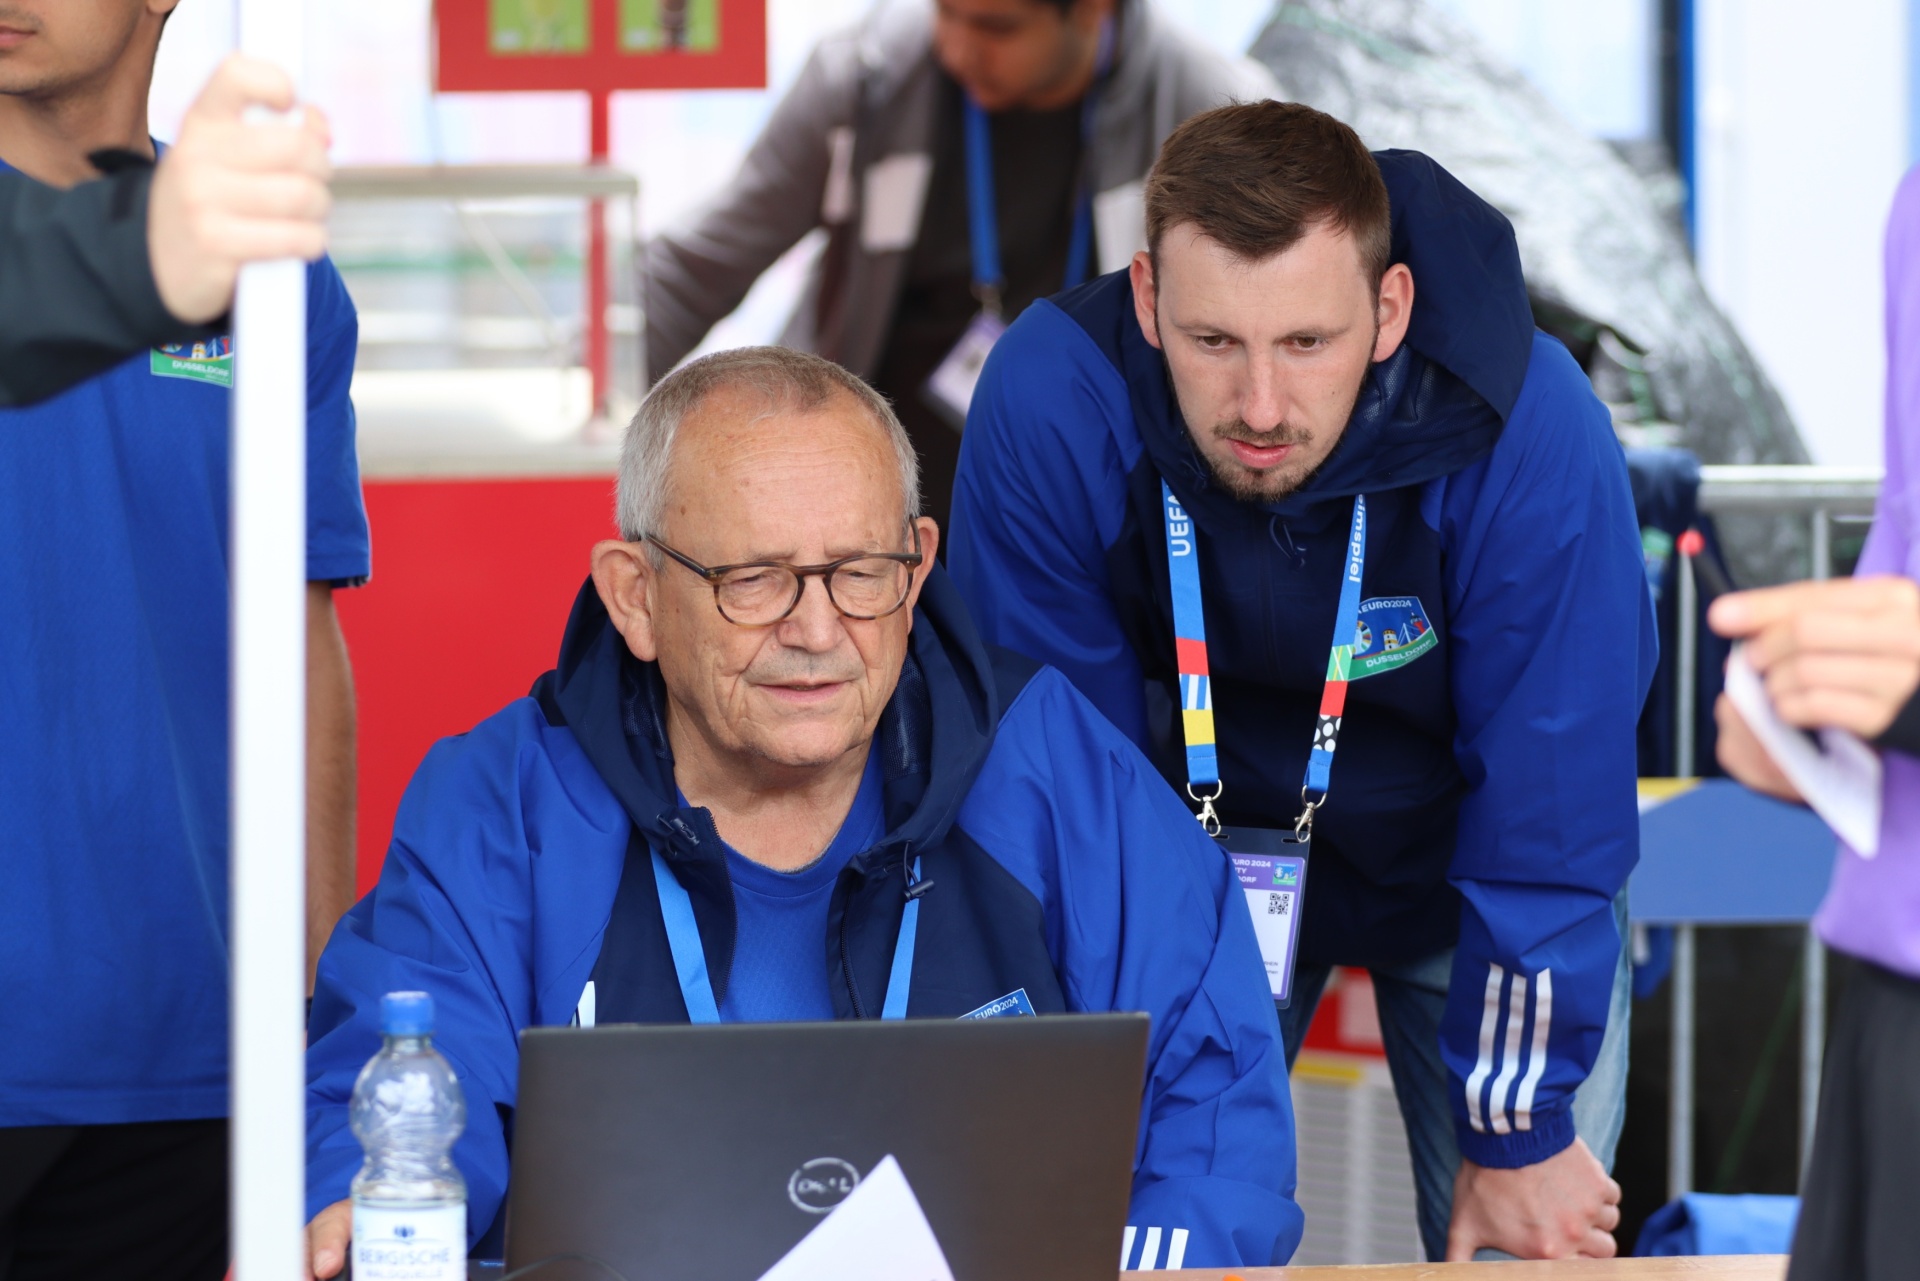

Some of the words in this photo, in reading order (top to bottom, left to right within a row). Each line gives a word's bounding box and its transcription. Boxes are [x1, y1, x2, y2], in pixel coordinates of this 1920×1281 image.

[1366, 639, 1431, 668] DUSSELDORF
[1251, 860, 1272, 868] 2024
[360, 1247, 451, 1265] BERGISCHE
